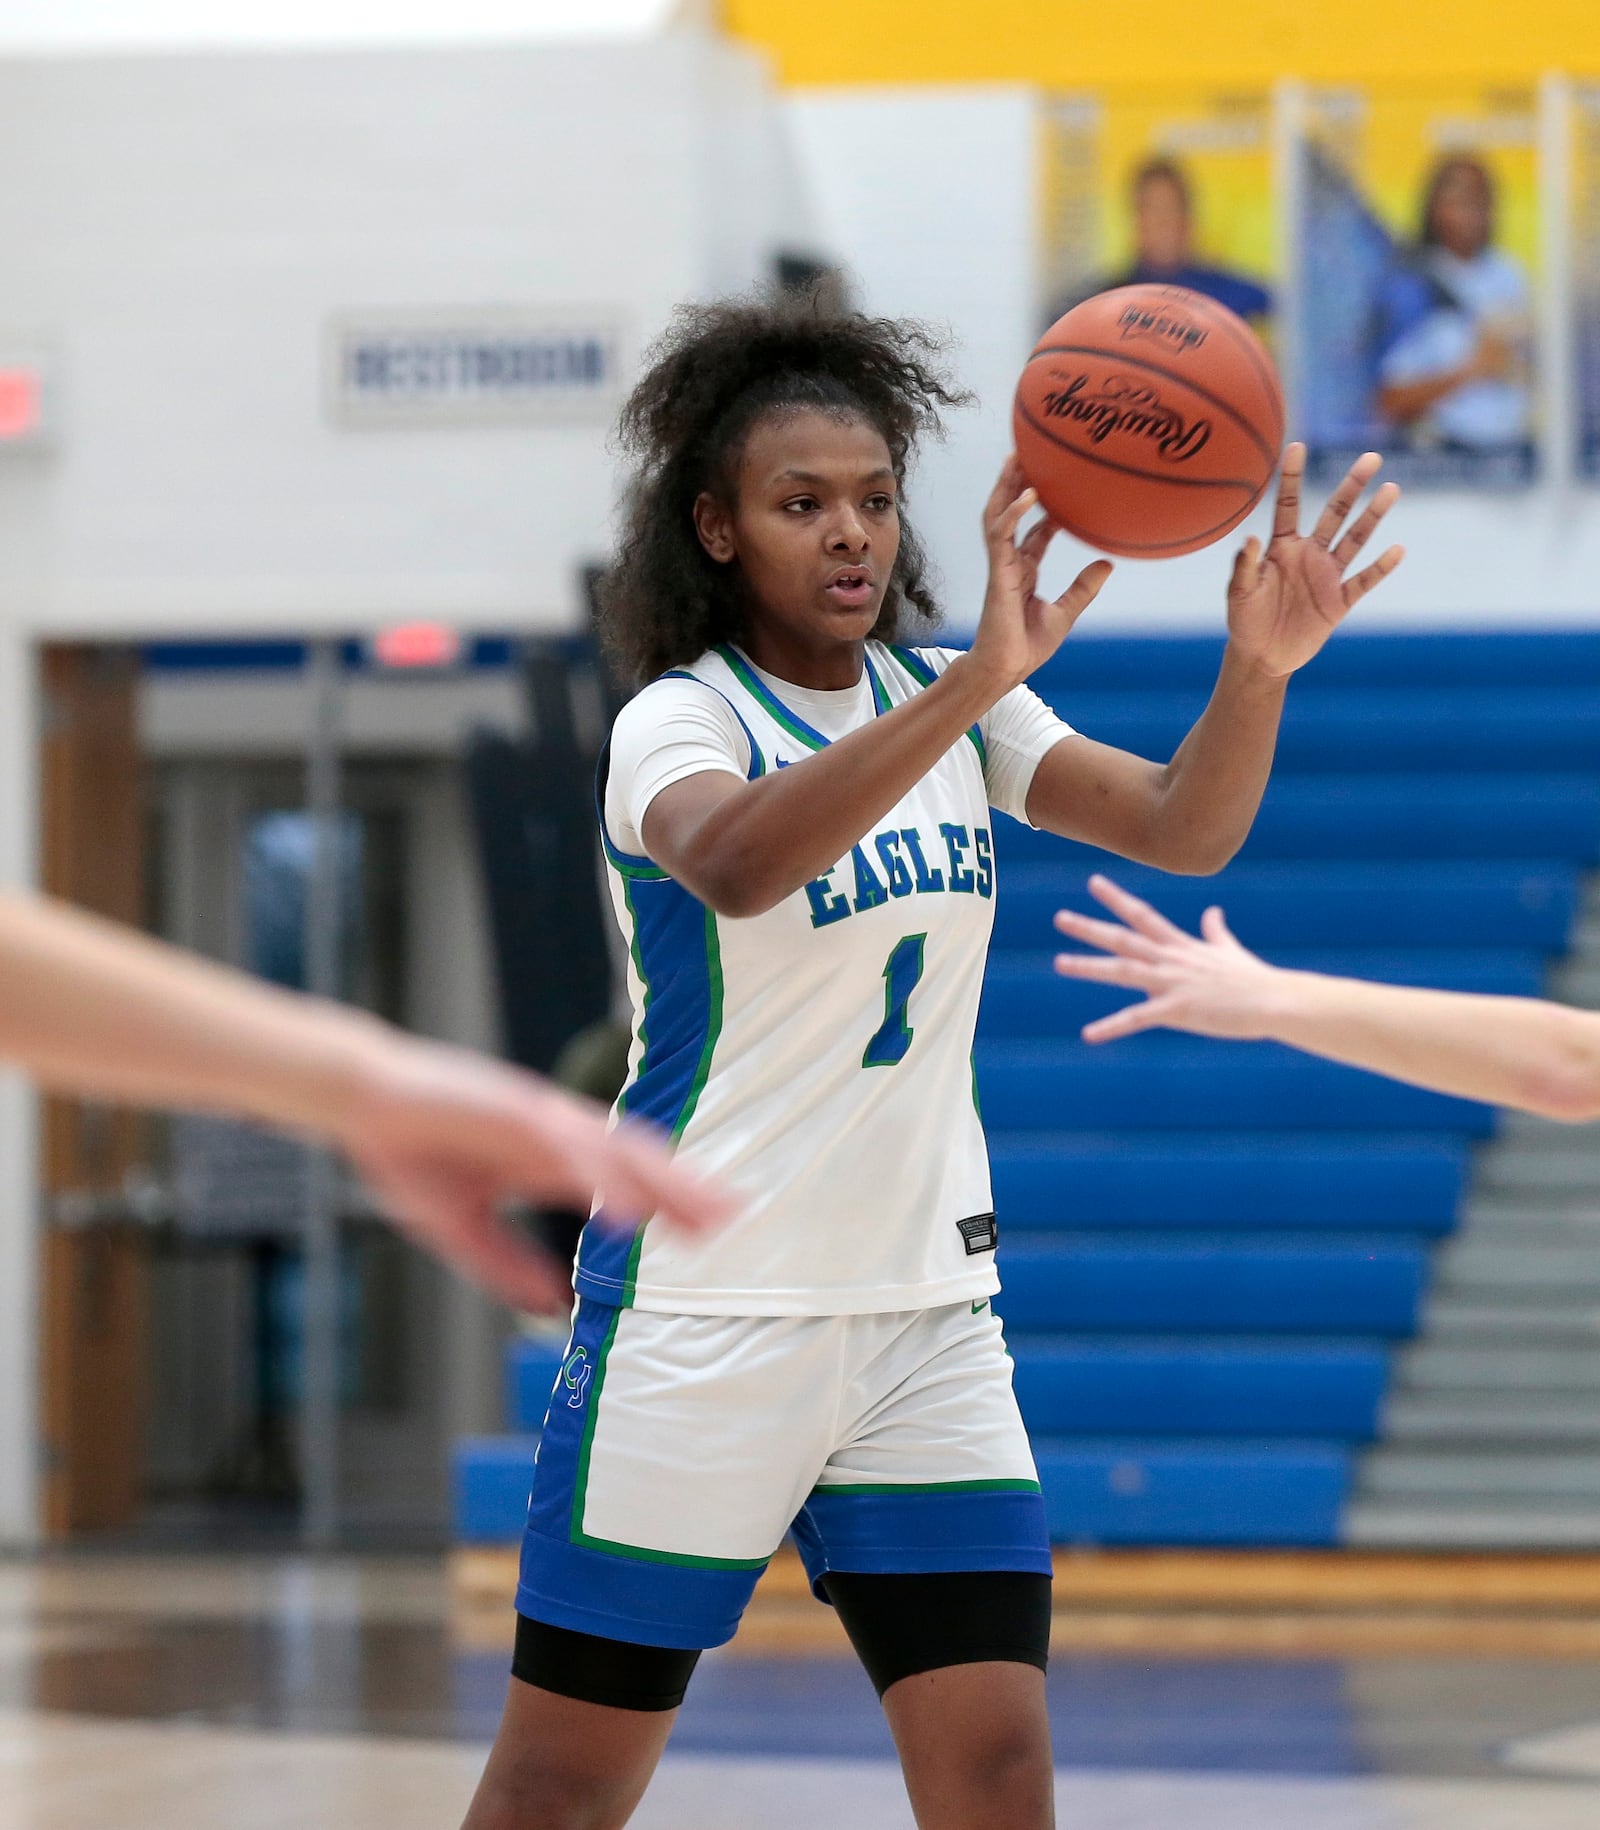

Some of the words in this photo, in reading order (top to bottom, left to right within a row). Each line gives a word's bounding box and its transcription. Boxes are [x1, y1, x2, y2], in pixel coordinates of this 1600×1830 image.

[1042, 375, 1213, 464] Rawlings
[804, 822, 993, 929] EAGLES
[861, 931, 928, 1068] 1
